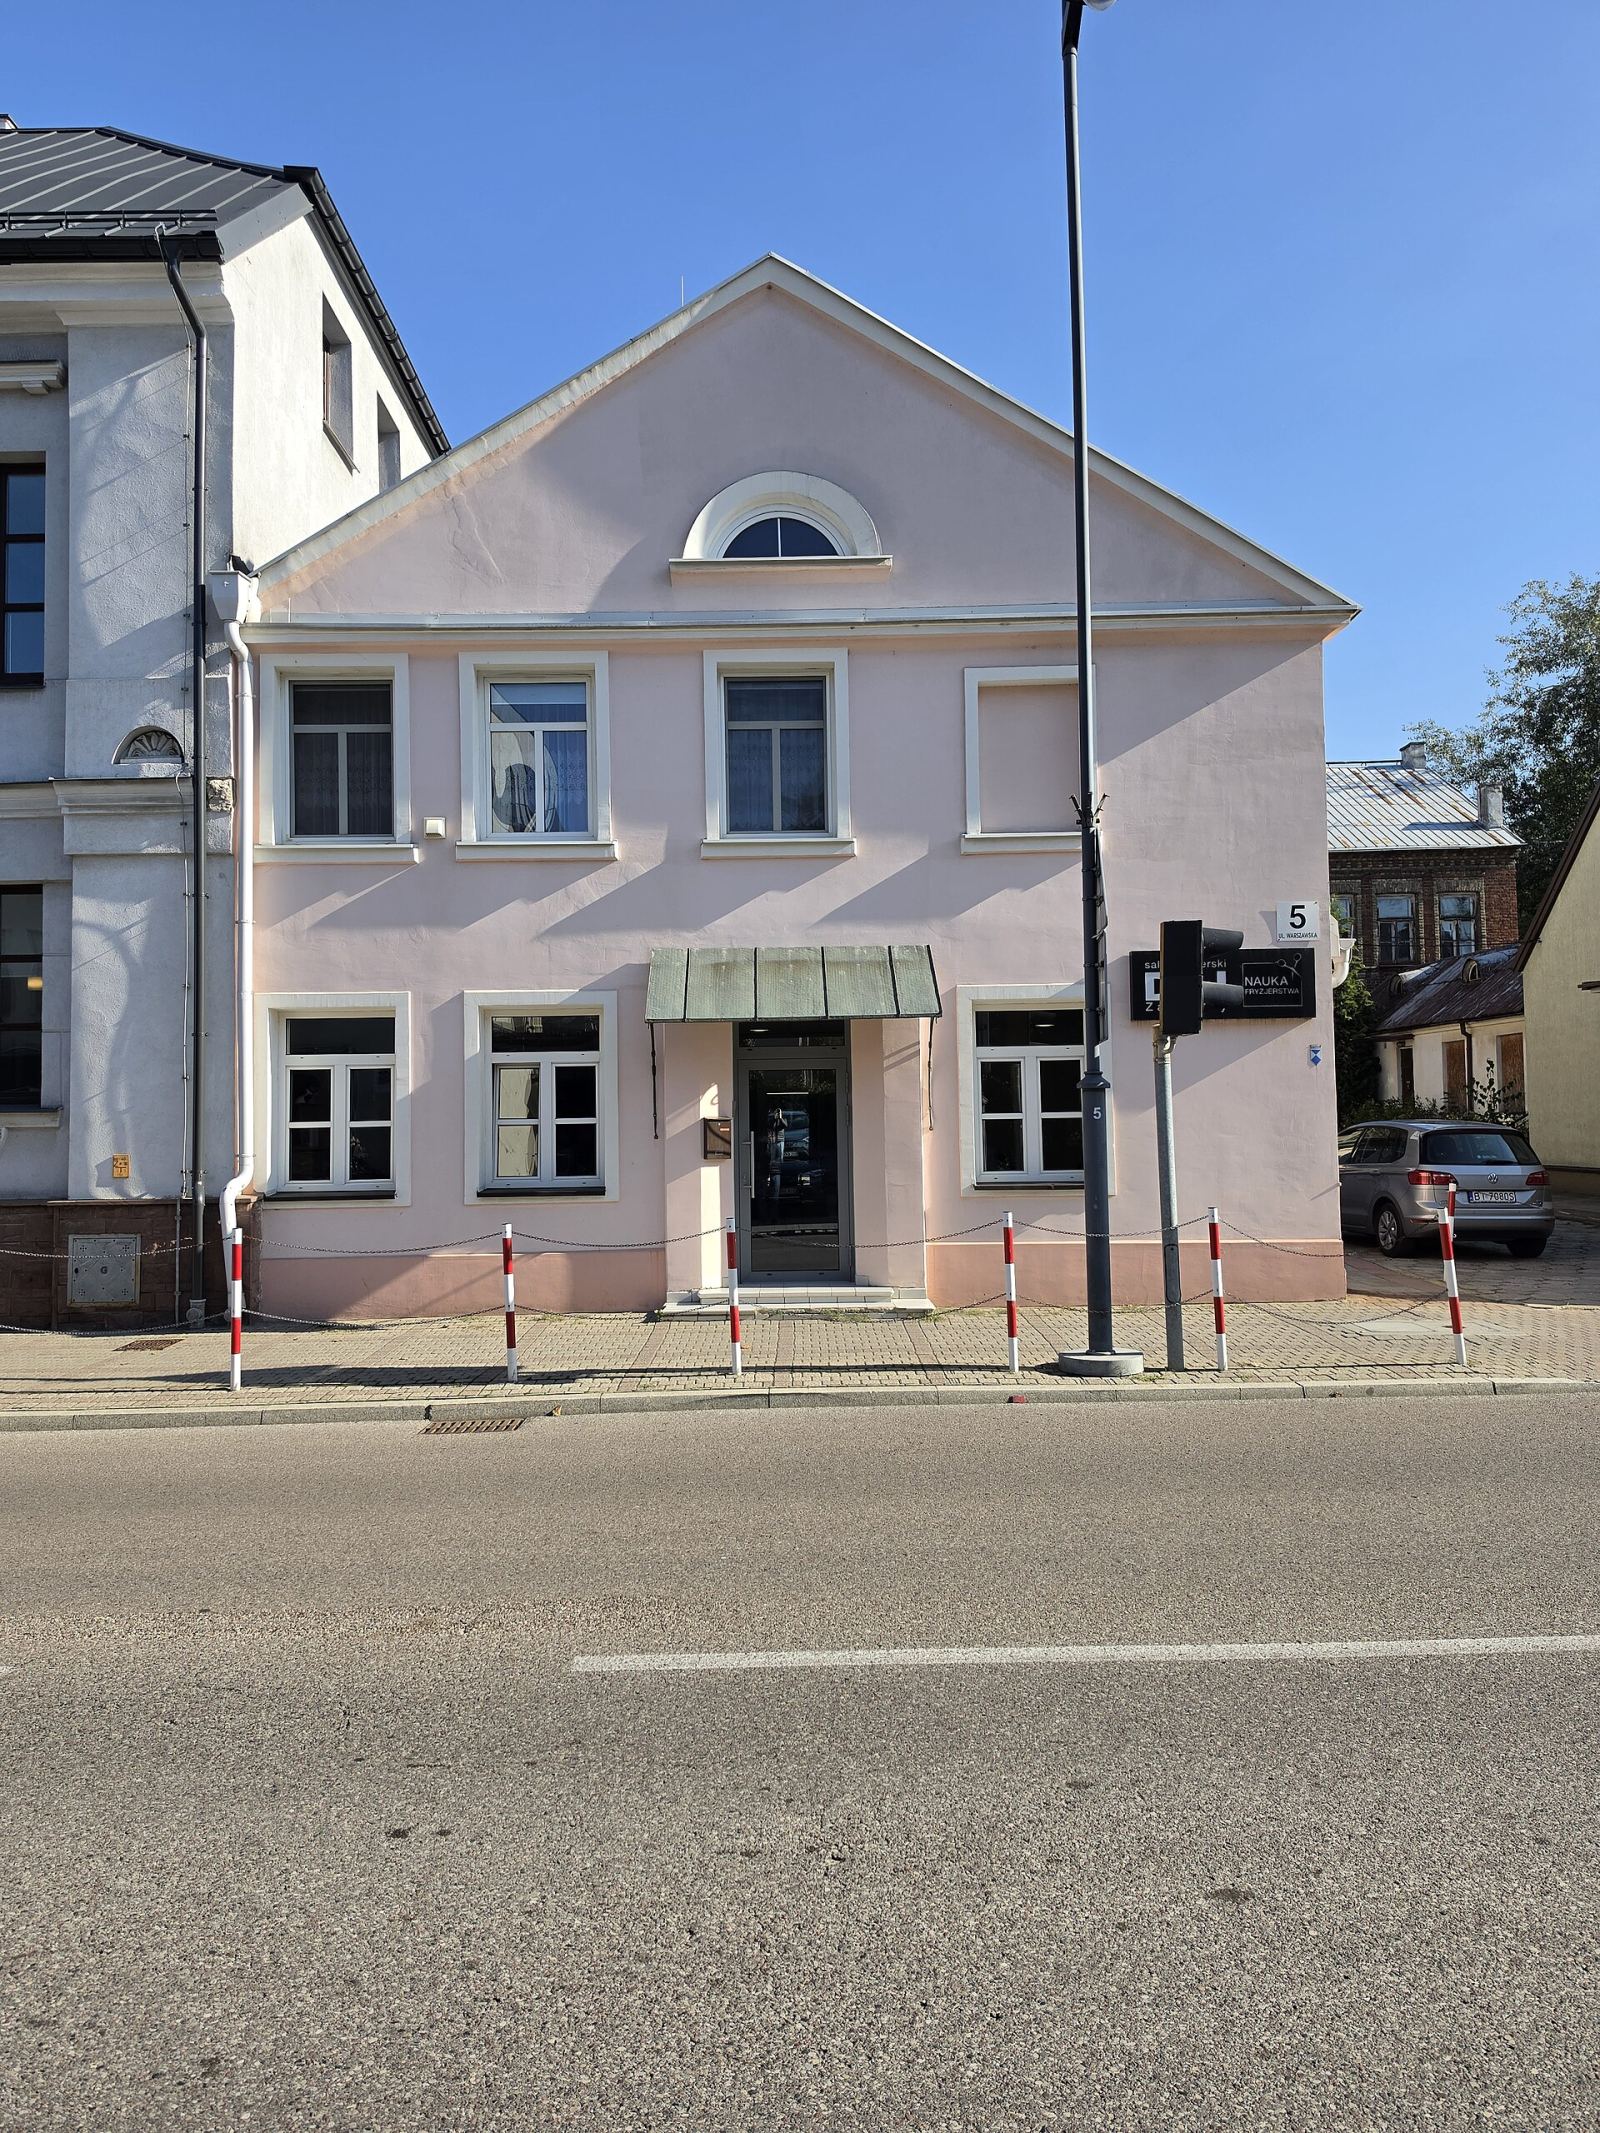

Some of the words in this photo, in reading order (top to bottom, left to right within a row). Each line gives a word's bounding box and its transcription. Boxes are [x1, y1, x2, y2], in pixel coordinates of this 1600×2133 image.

[1289, 905, 1306, 929] 5
[1244, 976, 1289, 986] NAUKA
[1244, 987, 1300, 995] FRYZJERSTWA
[1093, 1106, 1102, 1120] 5
